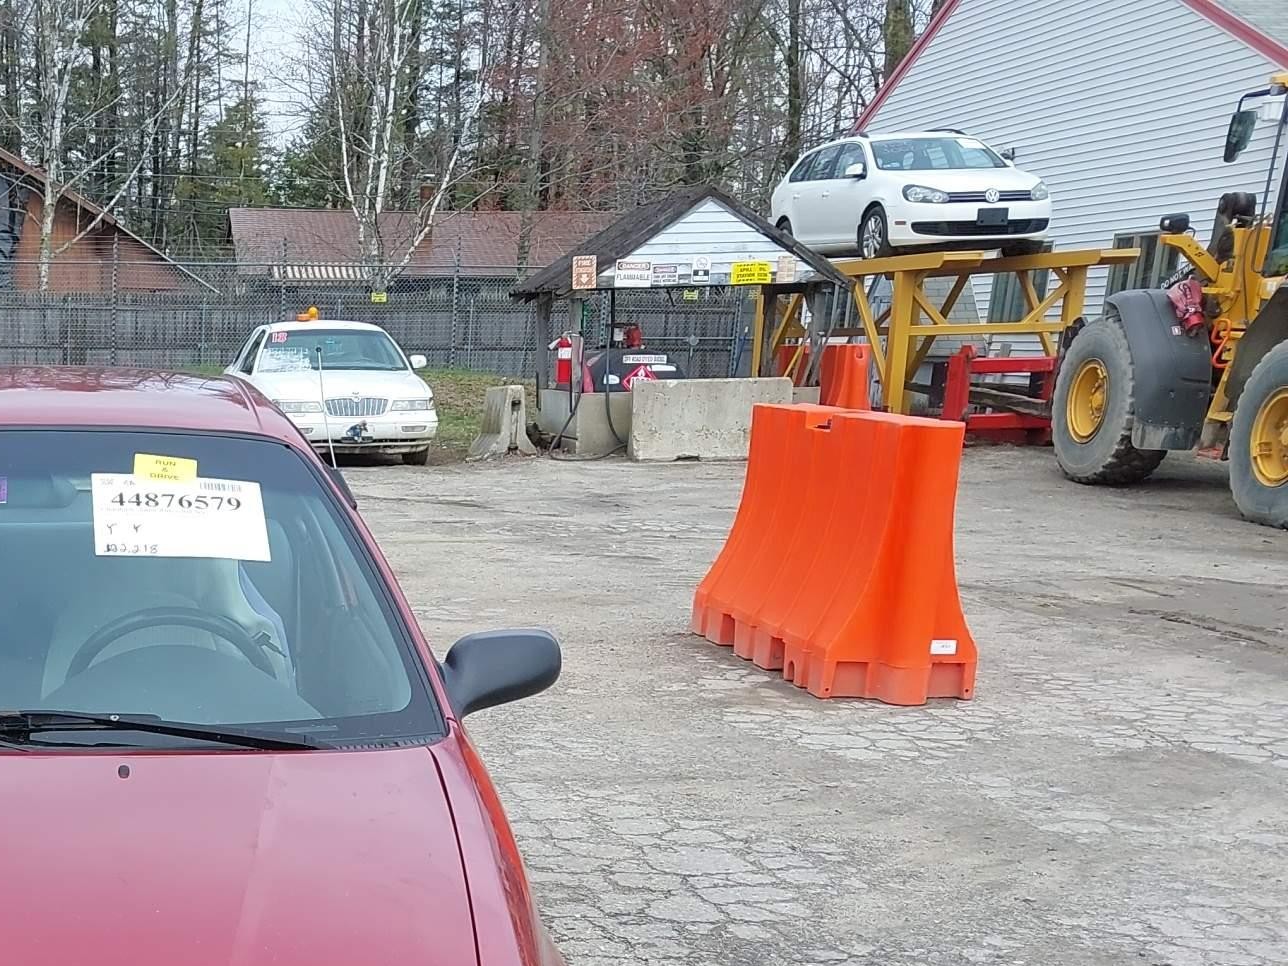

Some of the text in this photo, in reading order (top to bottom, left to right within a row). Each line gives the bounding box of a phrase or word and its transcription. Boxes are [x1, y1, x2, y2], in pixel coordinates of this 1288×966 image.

[616, 273, 650, 281] FLAMMABLE
[155, 459, 177, 467] RUN
[149, 472, 180, 481] DRIVE
[111, 491, 242, 511] 44876579
